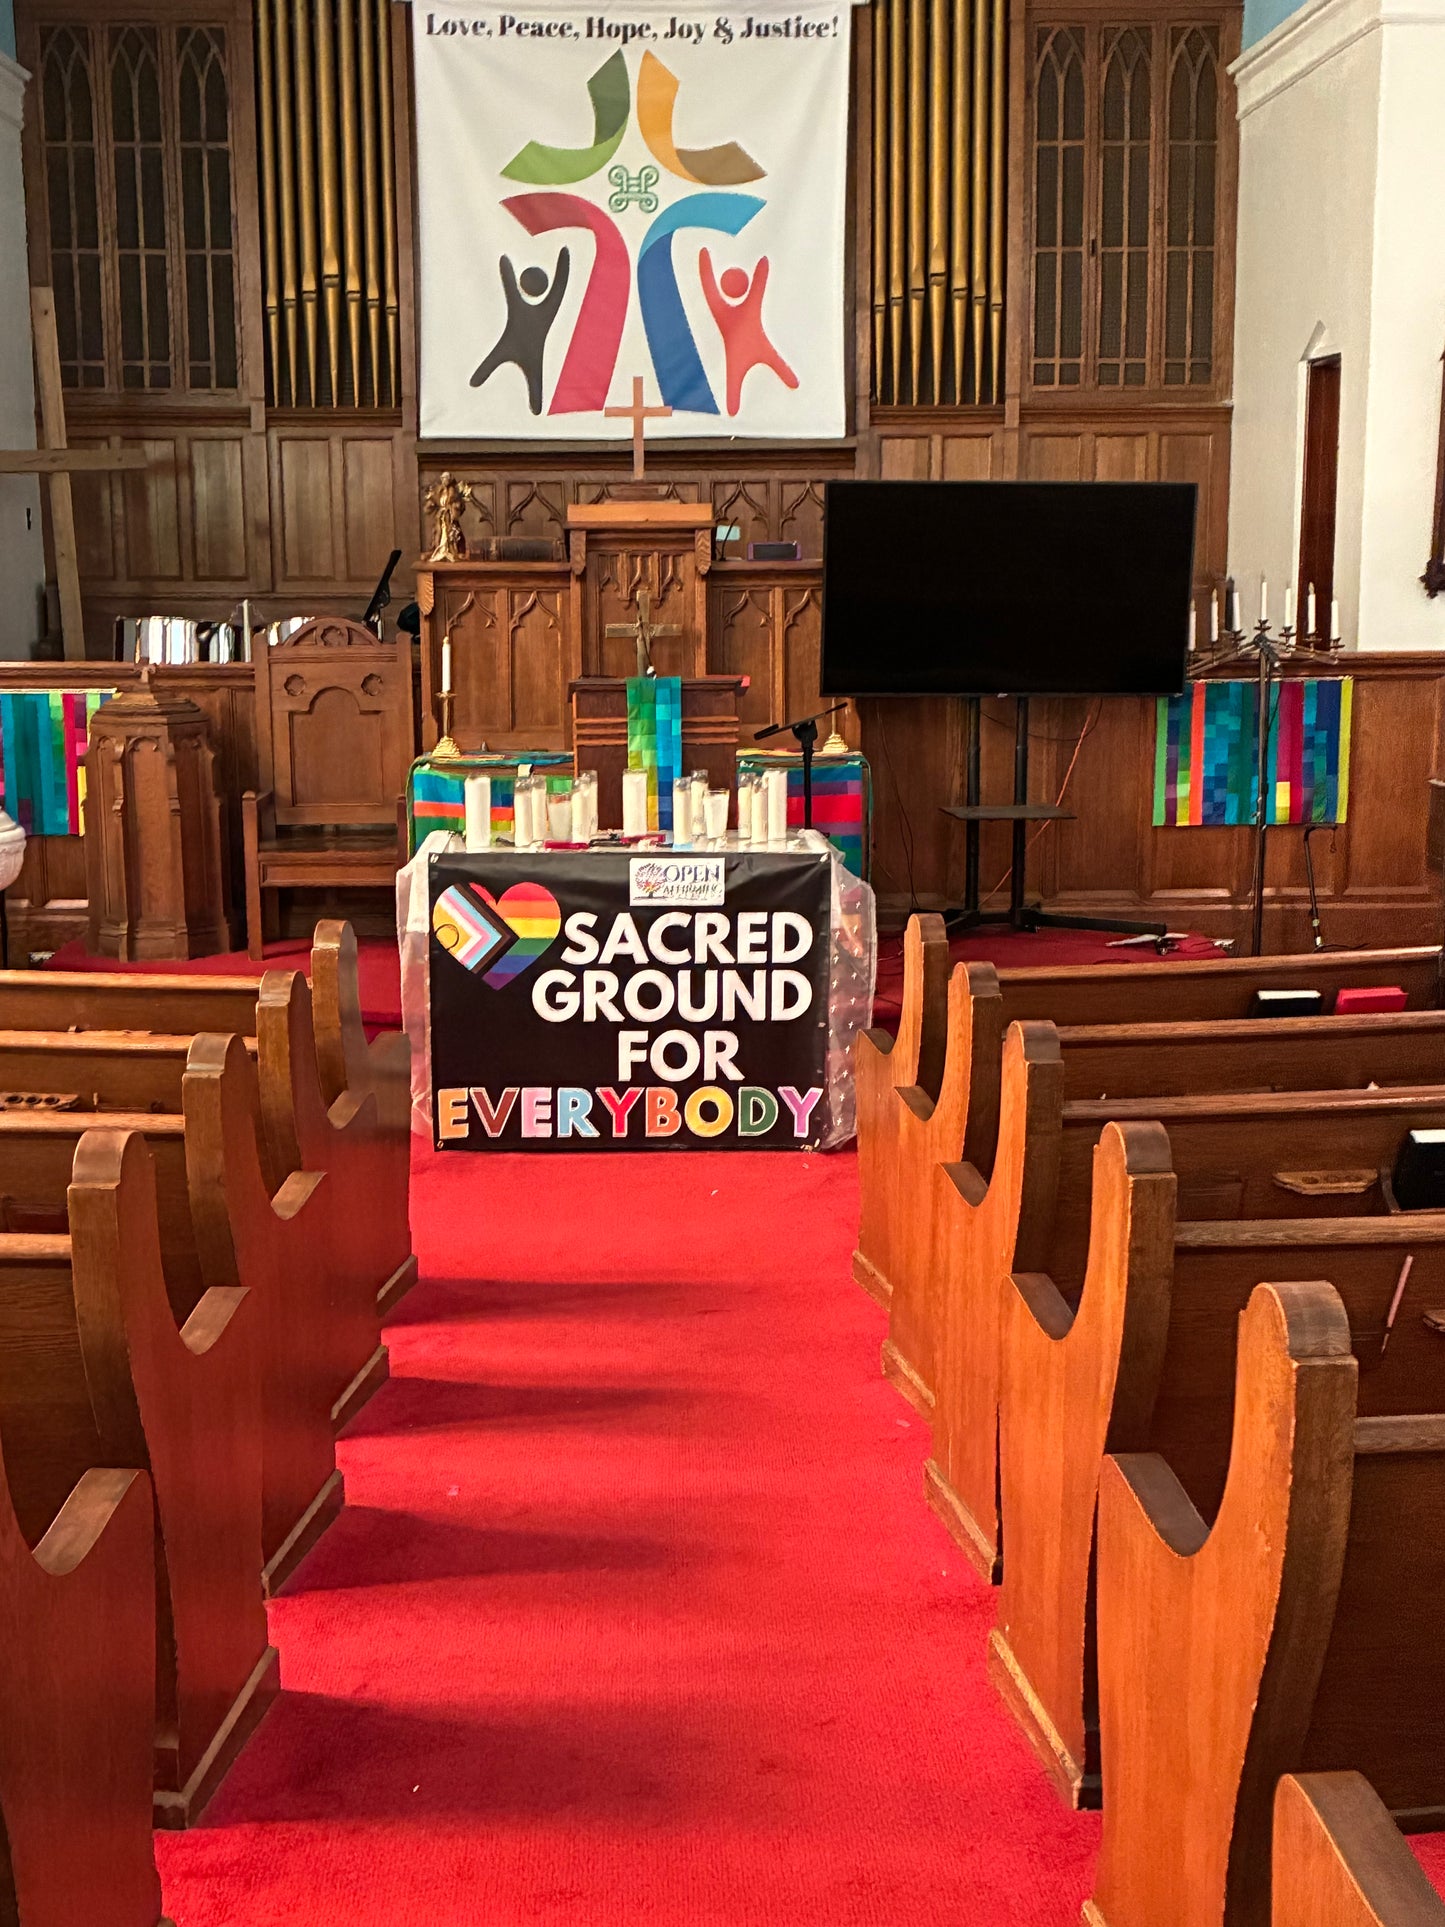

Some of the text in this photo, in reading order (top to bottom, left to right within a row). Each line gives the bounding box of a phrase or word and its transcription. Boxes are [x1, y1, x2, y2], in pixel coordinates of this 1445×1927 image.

[426, 13, 839, 45] Love, Peace, Hope, Joy & Justice!
[663, 865, 720, 882] OPEN
[560, 911, 814, 965] SACRED
[531, 969, 814, 1023] GROUND
[618, 1029, 745, 1082] FOR
[438, 1086, 824, 1140] EVERYBODY
